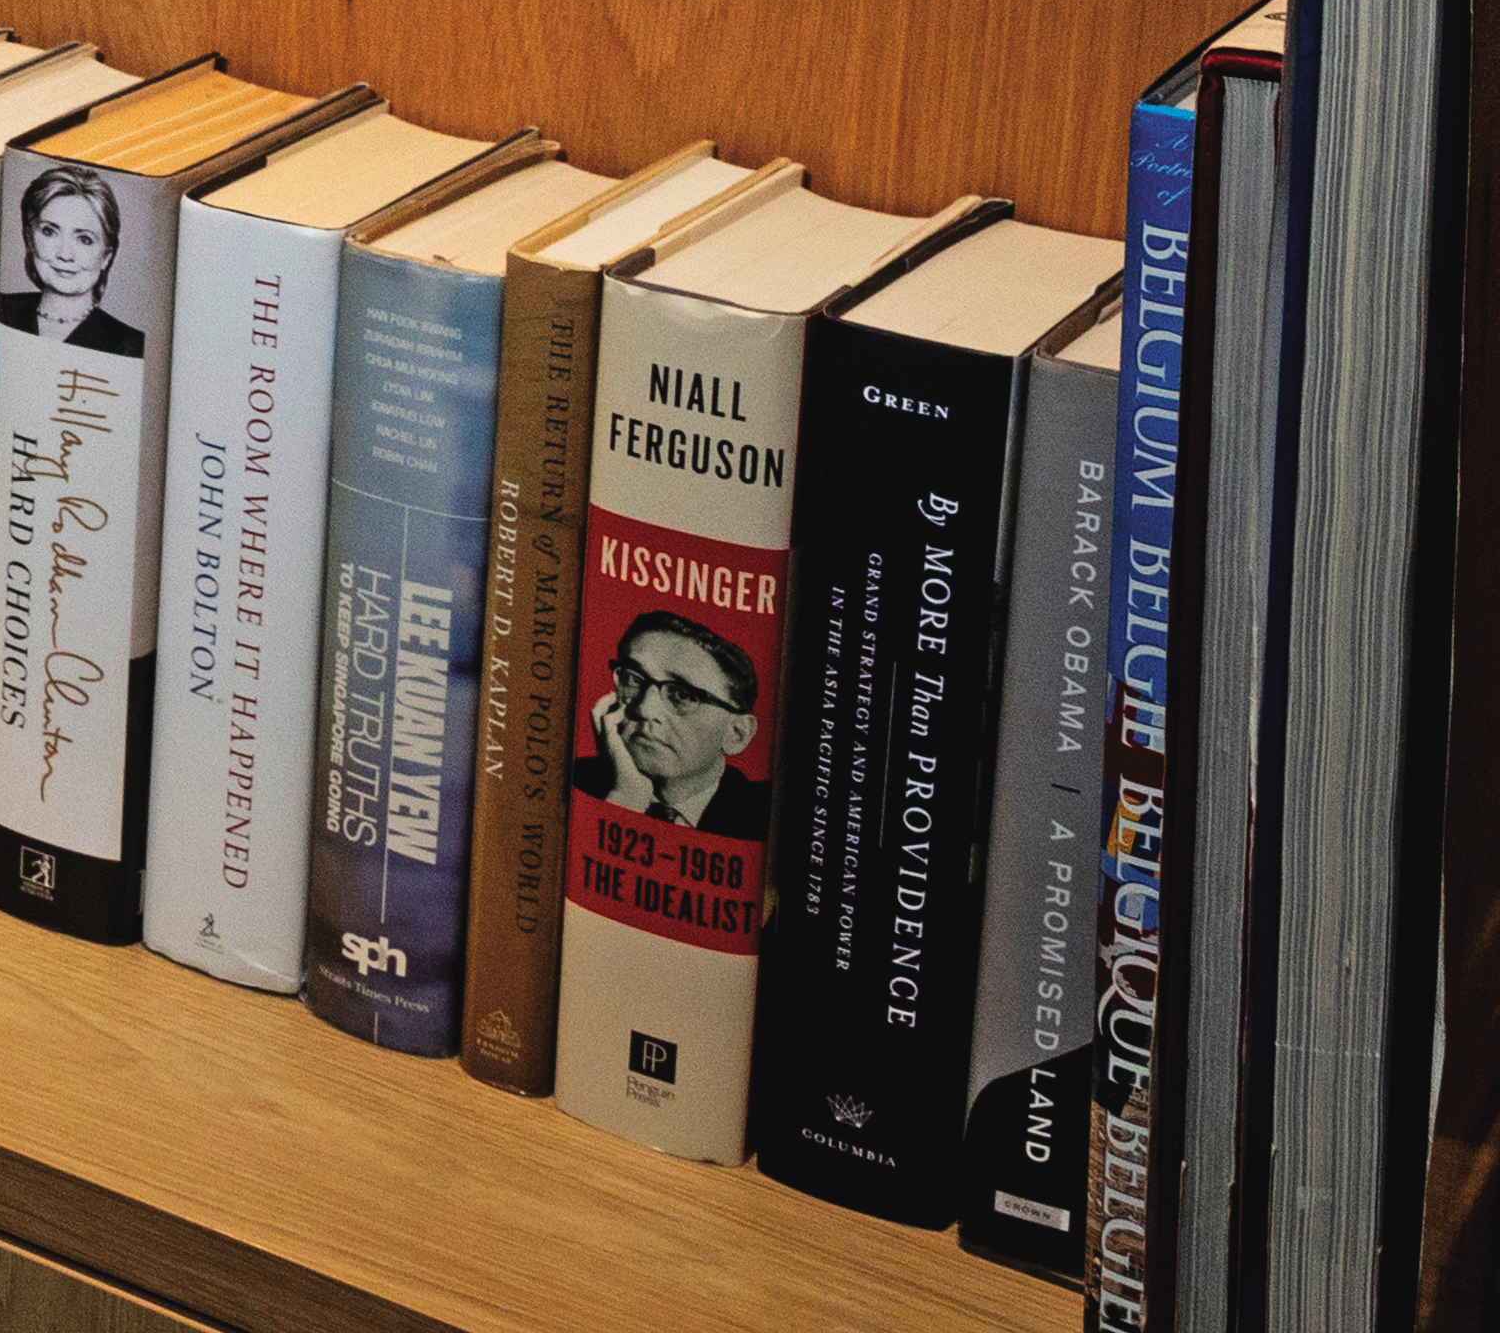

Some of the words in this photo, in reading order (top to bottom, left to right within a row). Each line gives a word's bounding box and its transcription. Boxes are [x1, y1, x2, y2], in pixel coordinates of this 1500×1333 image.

[251, 275, 281, 348] THE
[549, 319, 574, 382] THE
[647, 362, 748, 424] NIALL
[1131, 219, 1190, 511] BELGIUM
[24, 368, 119, 484] Hillary
[244, 363, 276, 477] ROOM
[540, 394, 569, 525] RETURN
[608, 411, 786, 490] FERGUSON
[8, 430, 38, 547] HARD
[195, 432, 226, 540] JOHN
[917, 491, 959, 527] By
[48, 496, 109, 649] Rodham
[236, 495, 269, 626] WHERE
[339, 562, 354, 589] TO
[493, 479, 520, 607] ROBERT
[532, 533, 560, 564] of
[599, 533, 777, 615] KISSINGER
[1069, 458, 1105, 611] BARACK
[190, 550, 220, 701] BOLTON
[337, 591, 352, 650] KEEP
[352, 564, 391, 681] HARD
[399, 580, 453, 651] LEE
[490, 614, 512, 638] D.
[531, 569, 558, 683] MARCO
[831, 586, 845, 610] IN
[864, 551, 883, 623] GRAND
[916, 542, 954, 655] MORE
[0, 561, 32, 730] CHOICES
[234, 640, 260, 680] IT
[826, 617, 843, 657] THE
[330, 652, 349, 768] SINGAPORE
[392, 649, 449, 767] KUAN
[485, 654, 510, 780] KAPLAN
[822, 664, 839, 711] ASIA
[854, 629, 876, 734] STRATEGY
[909, 670, 945, 737] Than
[1056, 624, 1092, 752] OBAMA
[41, 651, 104, 802] Clinton
[342, 690, 385, 848] TRUTHS
[524, 693, 551, 803] POLO'S
[816, 718, 835, 800] PACIFIC
[850, 738, 867, 784] AND
[222, 692, 258, 889] HAPPENED
[326, 768, 342, 834] GOING
[387, 771, 441, 865] YEW
[1051, 818, 1074, 844] A
[515, 823, 544, 935] WORLD
[810, 806, 827, 866] SINCE
[841, 790, 864, 895] AMERICAN
[581, 853, 625, 902] THE
[634, 875, 755, 935] IDEALIST
[806, 873, 822, 916] 1783
[887, 751, 937, 1028] PROVIDENCE
[1098, 772, 1162, 1090] BELGIQUE
[341, 931, 407, 978] sph
[835, 902, 855, 972] POWER
[1032, 859, 1072, 1052] PROMISED
[319, 964, 352, 990] Straits
[354, 978, 391, 1005] Times
[395, 995, 430, 1014] Press
[626, 1087, 660, 1108] Press
[627, 1074, 675, 1098] Penguin
[1025, 1066, 1059, 1165] LAND
[801, 1127, 896, 1168] COLUMBIA
[1004, 1199, 1051, 1220] CROWN
